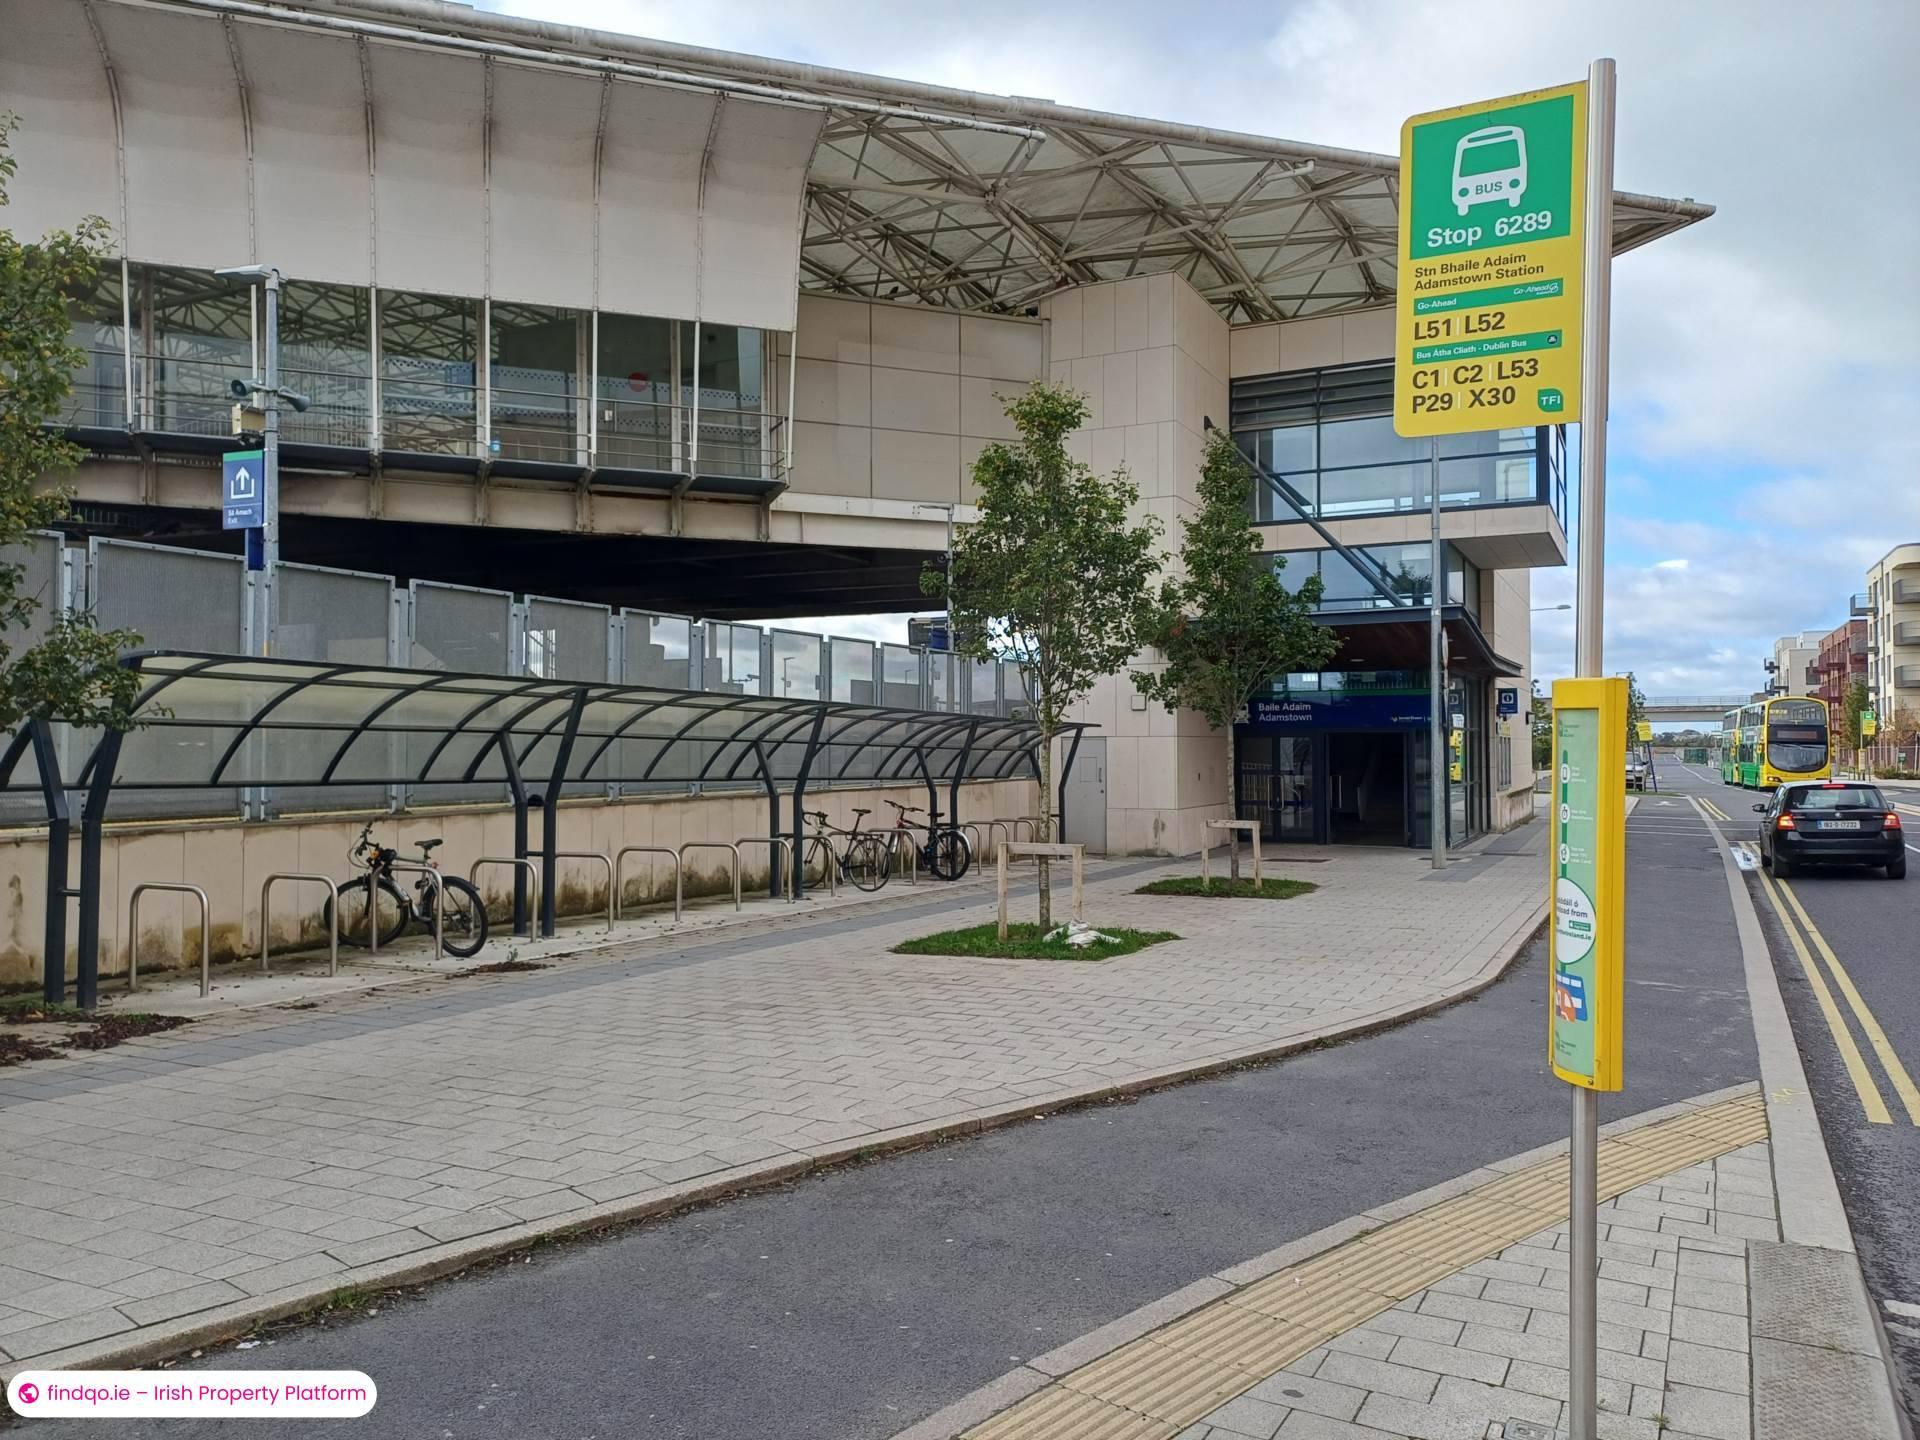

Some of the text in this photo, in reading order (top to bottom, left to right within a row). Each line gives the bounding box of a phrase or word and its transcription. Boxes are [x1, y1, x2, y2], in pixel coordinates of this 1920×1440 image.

[1475, 181, 1503, 195] BUS
[1427, 210, 1552, 248] Stop 6289
[1415, 253, 1526, 279] Stn Bhaile Adaim
[1414, 264, 1544, 291] Adamstown Station
[1417, 298, 1457, 310] Go-Ahead
[1414, 311, 1505, 340] L51 L52
[1416, 351, 1431, 359] Bus
[1453, 345, 1477, 355] Cliath
[1483, 341, 1510, 351] Dublin
[1511, 339, 1527, 347] Bus
[1412, 358, 1539, 390] C1 C2 L53
[1412, 386, 1516, 414] P29 X30
[1540, 395, 1561, 405] TFI
[1258, 702, 1312, 711] Baile Adaim
[1259, 712, 1313, 722] Adamstown
[1571, 909, 1588, 918] from
